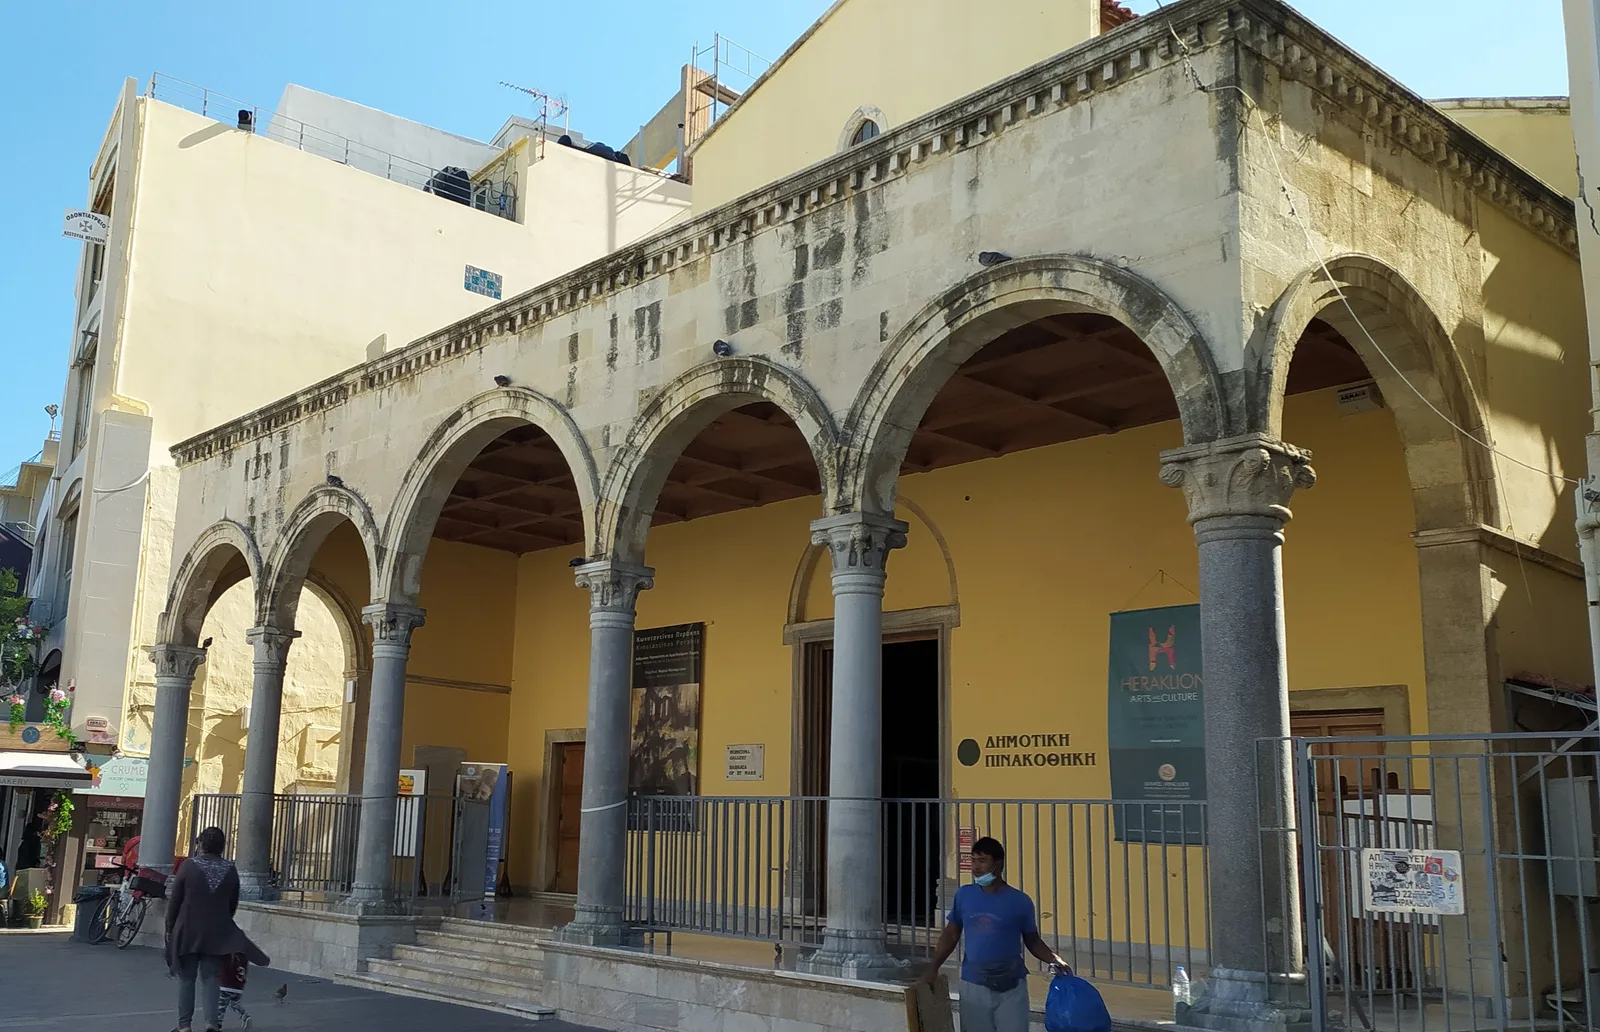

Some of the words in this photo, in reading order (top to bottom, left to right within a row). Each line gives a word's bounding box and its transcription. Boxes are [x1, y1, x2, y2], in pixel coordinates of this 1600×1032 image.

[66, 212, 106, 229] ΟΔΟΝΤΙΑΤΡΕΙΟ
[1120, 673, 1204, 691] HERAKLION
[1130, 694, 1151, 703] ARTS
[1161, 692, 1198, 702] CULTURE
[985, 733, 1070, 748] ΔΗΜΟΤΙΚΗ
[985, 752, 1096, 767] ΠΙΝΑΚΟΘΗΚΗ
